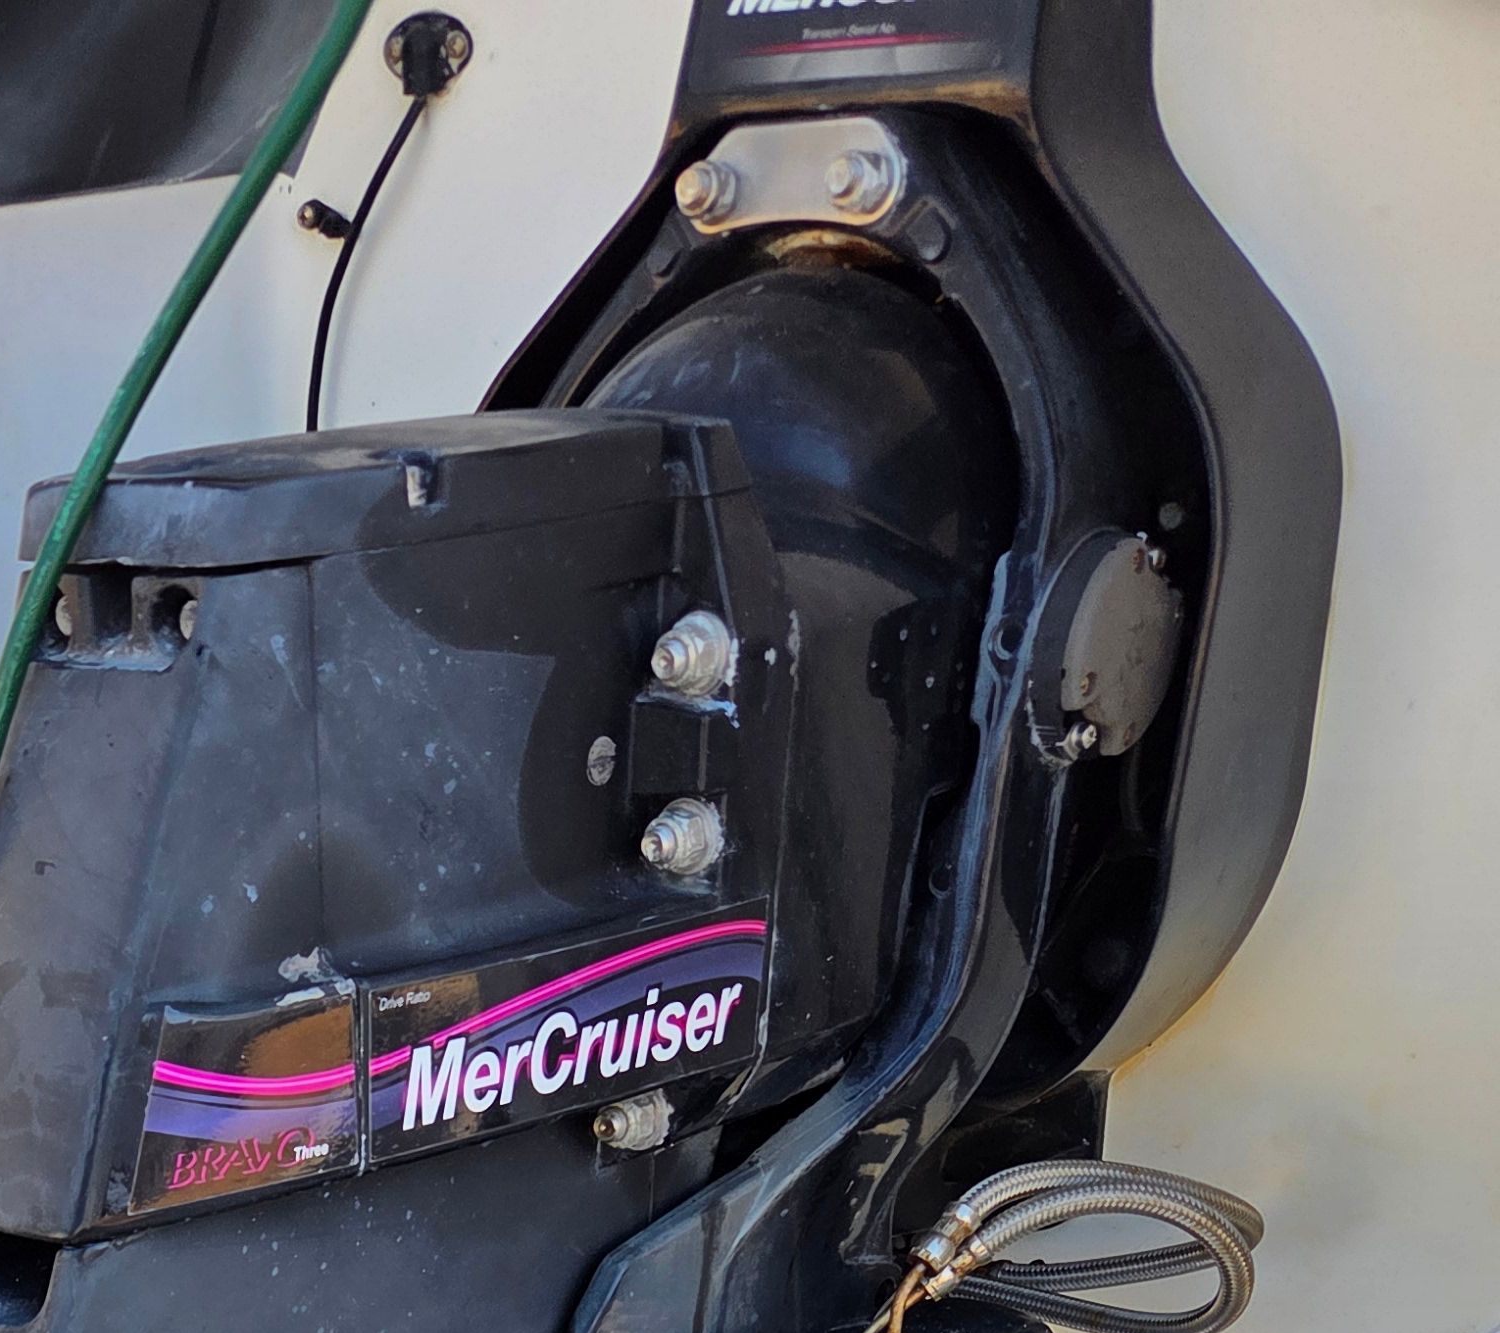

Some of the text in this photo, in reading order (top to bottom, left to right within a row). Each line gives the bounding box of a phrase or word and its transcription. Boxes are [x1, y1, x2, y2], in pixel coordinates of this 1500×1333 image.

[402, 983, 743, 1132] MerCruiser
[167, 1126, 330, 1190] BRAVO Three
